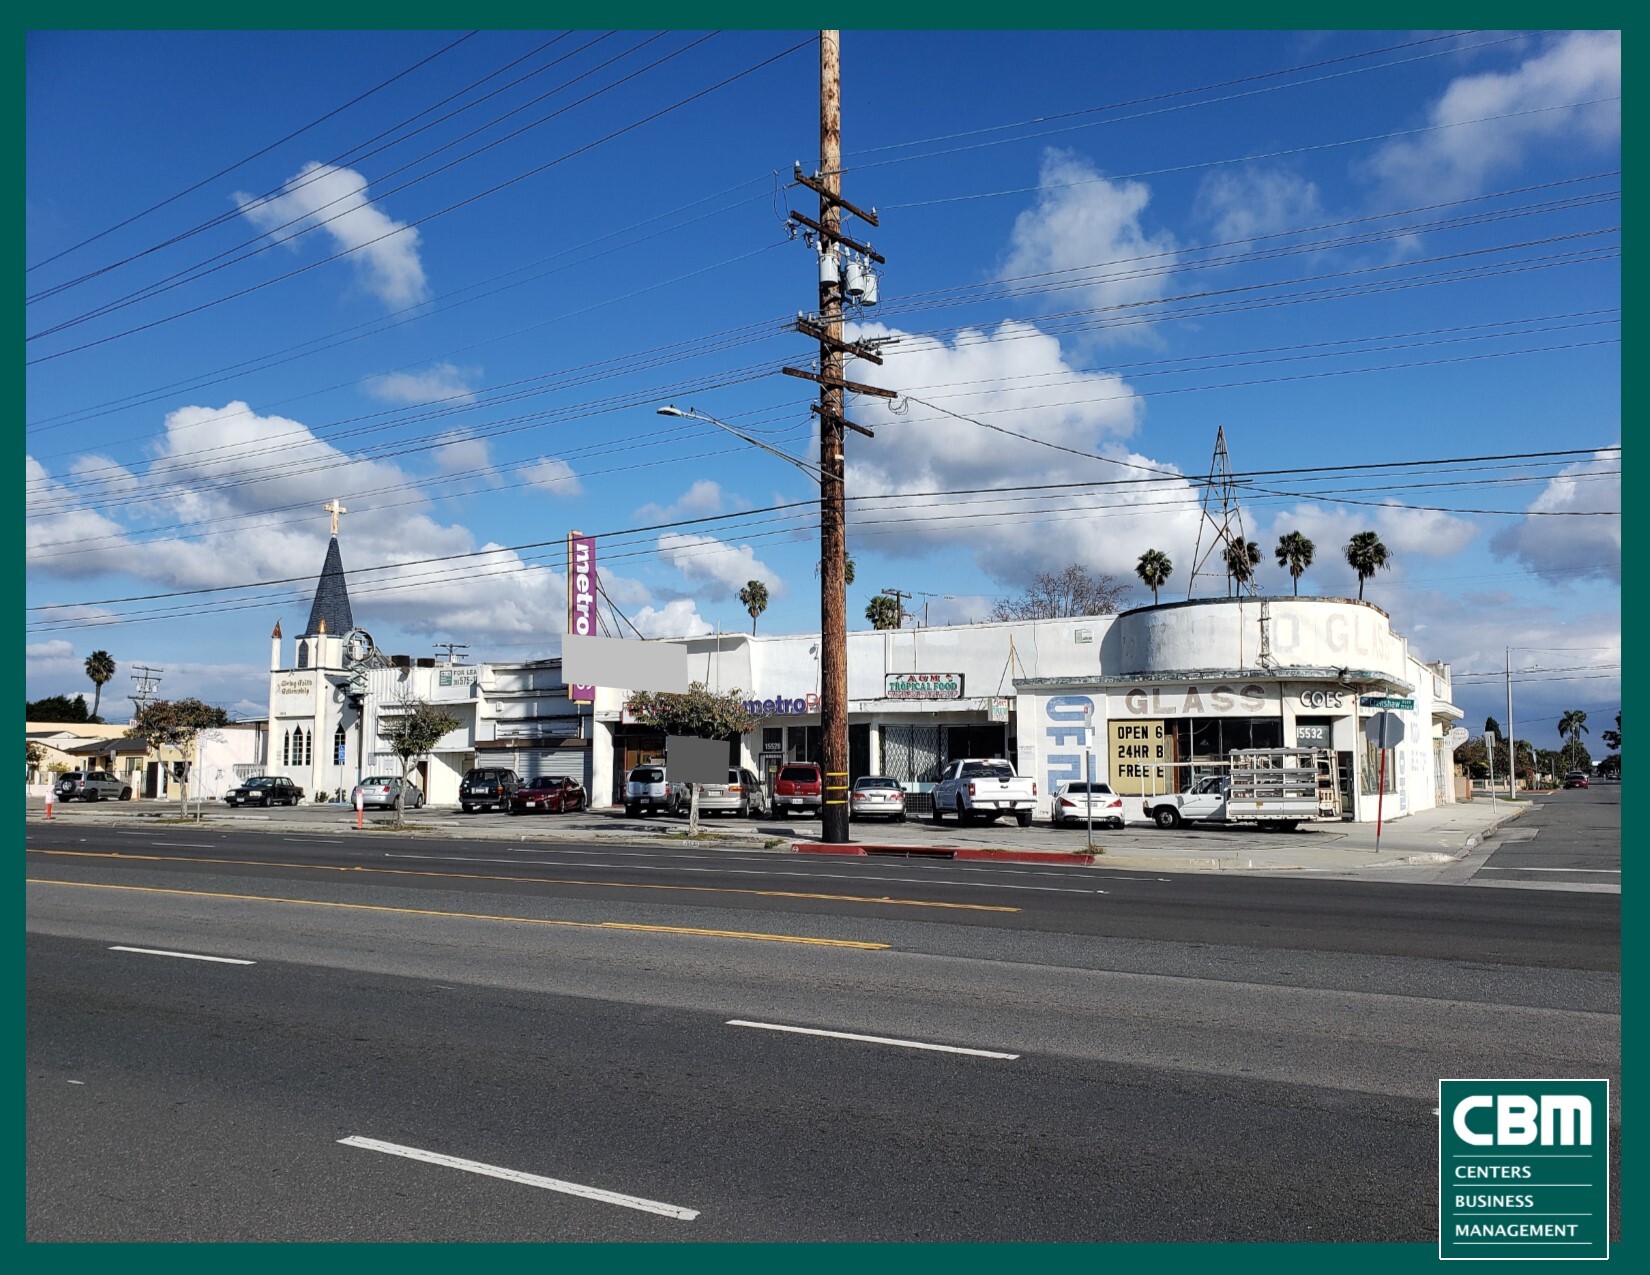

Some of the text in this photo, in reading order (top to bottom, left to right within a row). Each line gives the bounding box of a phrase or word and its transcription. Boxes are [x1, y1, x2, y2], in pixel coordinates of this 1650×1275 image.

[889, 682, 957, 691] TROPICAL FOOD
[742, 693, 822, 715] metroP
[1125, 684, 1265, 715] GLASS
[1300, 690, 1344, 709] COES
[1118, 726, 1148, 739] OPEN
[1297, 727, 1323, 739] 15532
[1118, 745, 1164, 758] 24HR B
[1118, 764, 1150, 778] FREE
